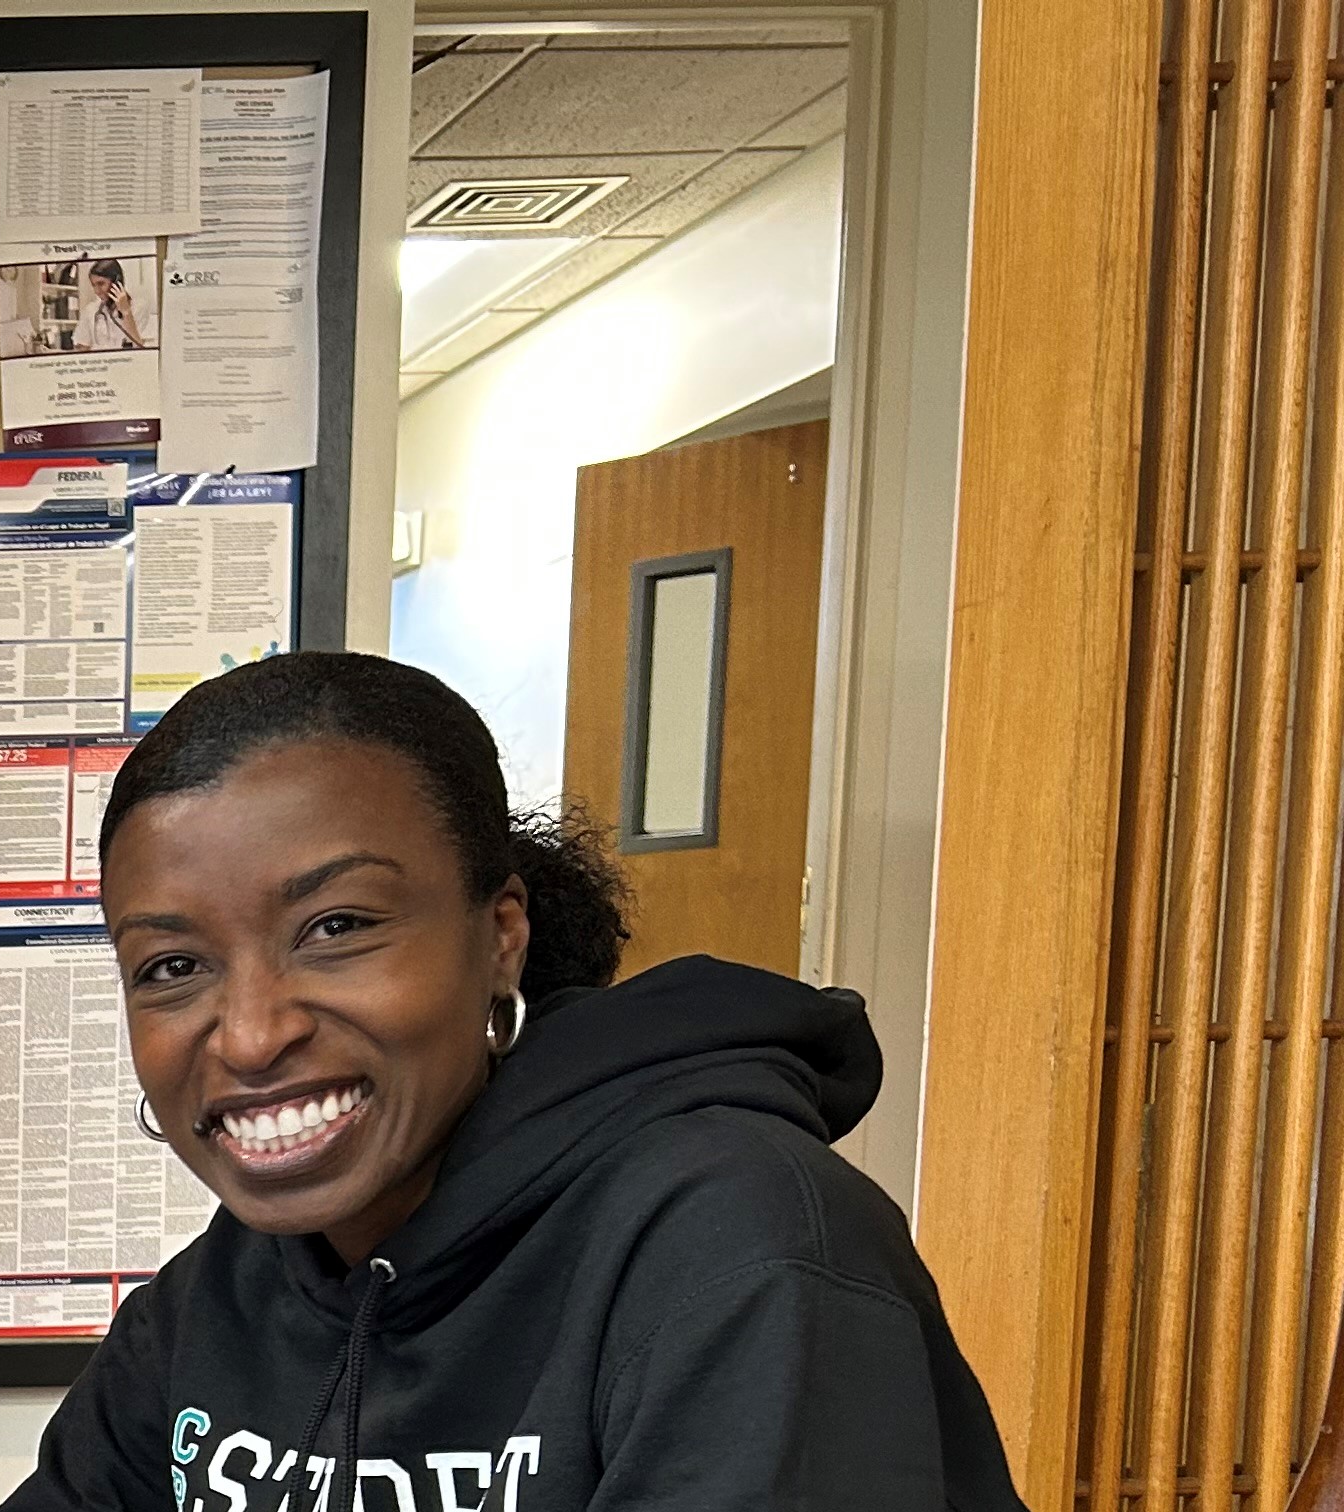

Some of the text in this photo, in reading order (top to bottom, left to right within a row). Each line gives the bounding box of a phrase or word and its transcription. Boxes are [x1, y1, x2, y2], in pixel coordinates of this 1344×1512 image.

[58, 470, 105, 482] FEDERAL
[228, 487, 244, 498] LA
[14, 907, 76, 917] CONNECTICUT
